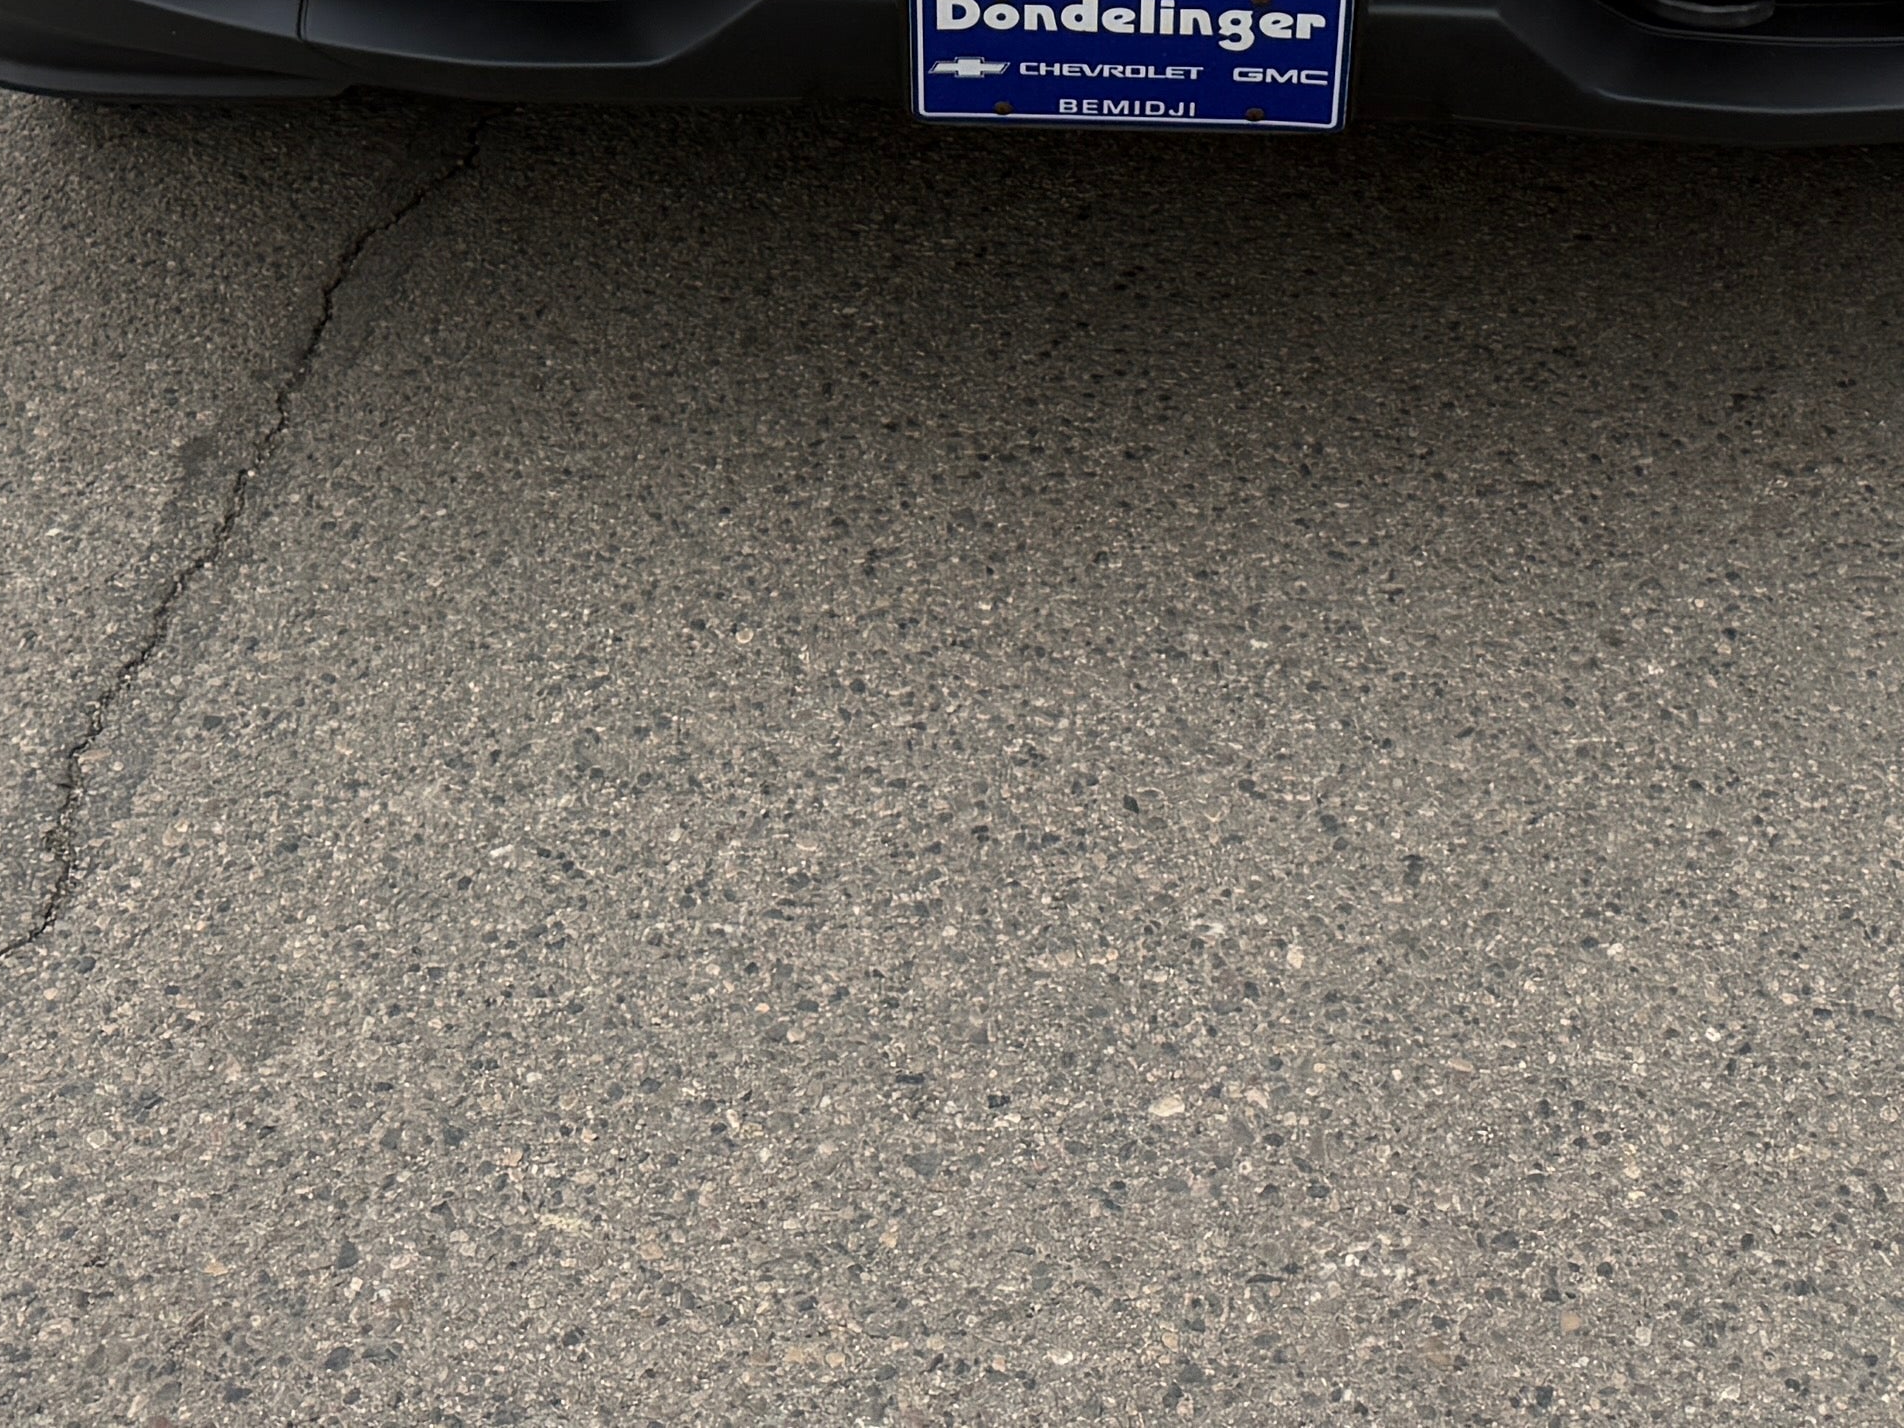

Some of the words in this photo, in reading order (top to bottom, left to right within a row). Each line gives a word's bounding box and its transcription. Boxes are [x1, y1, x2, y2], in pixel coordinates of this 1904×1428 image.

[1019, 62, 1204, 80] CHEVROLET
[1232, 67, 1329, 85] GMC
[1058, 99, 1196, 117] BEMIDJI
